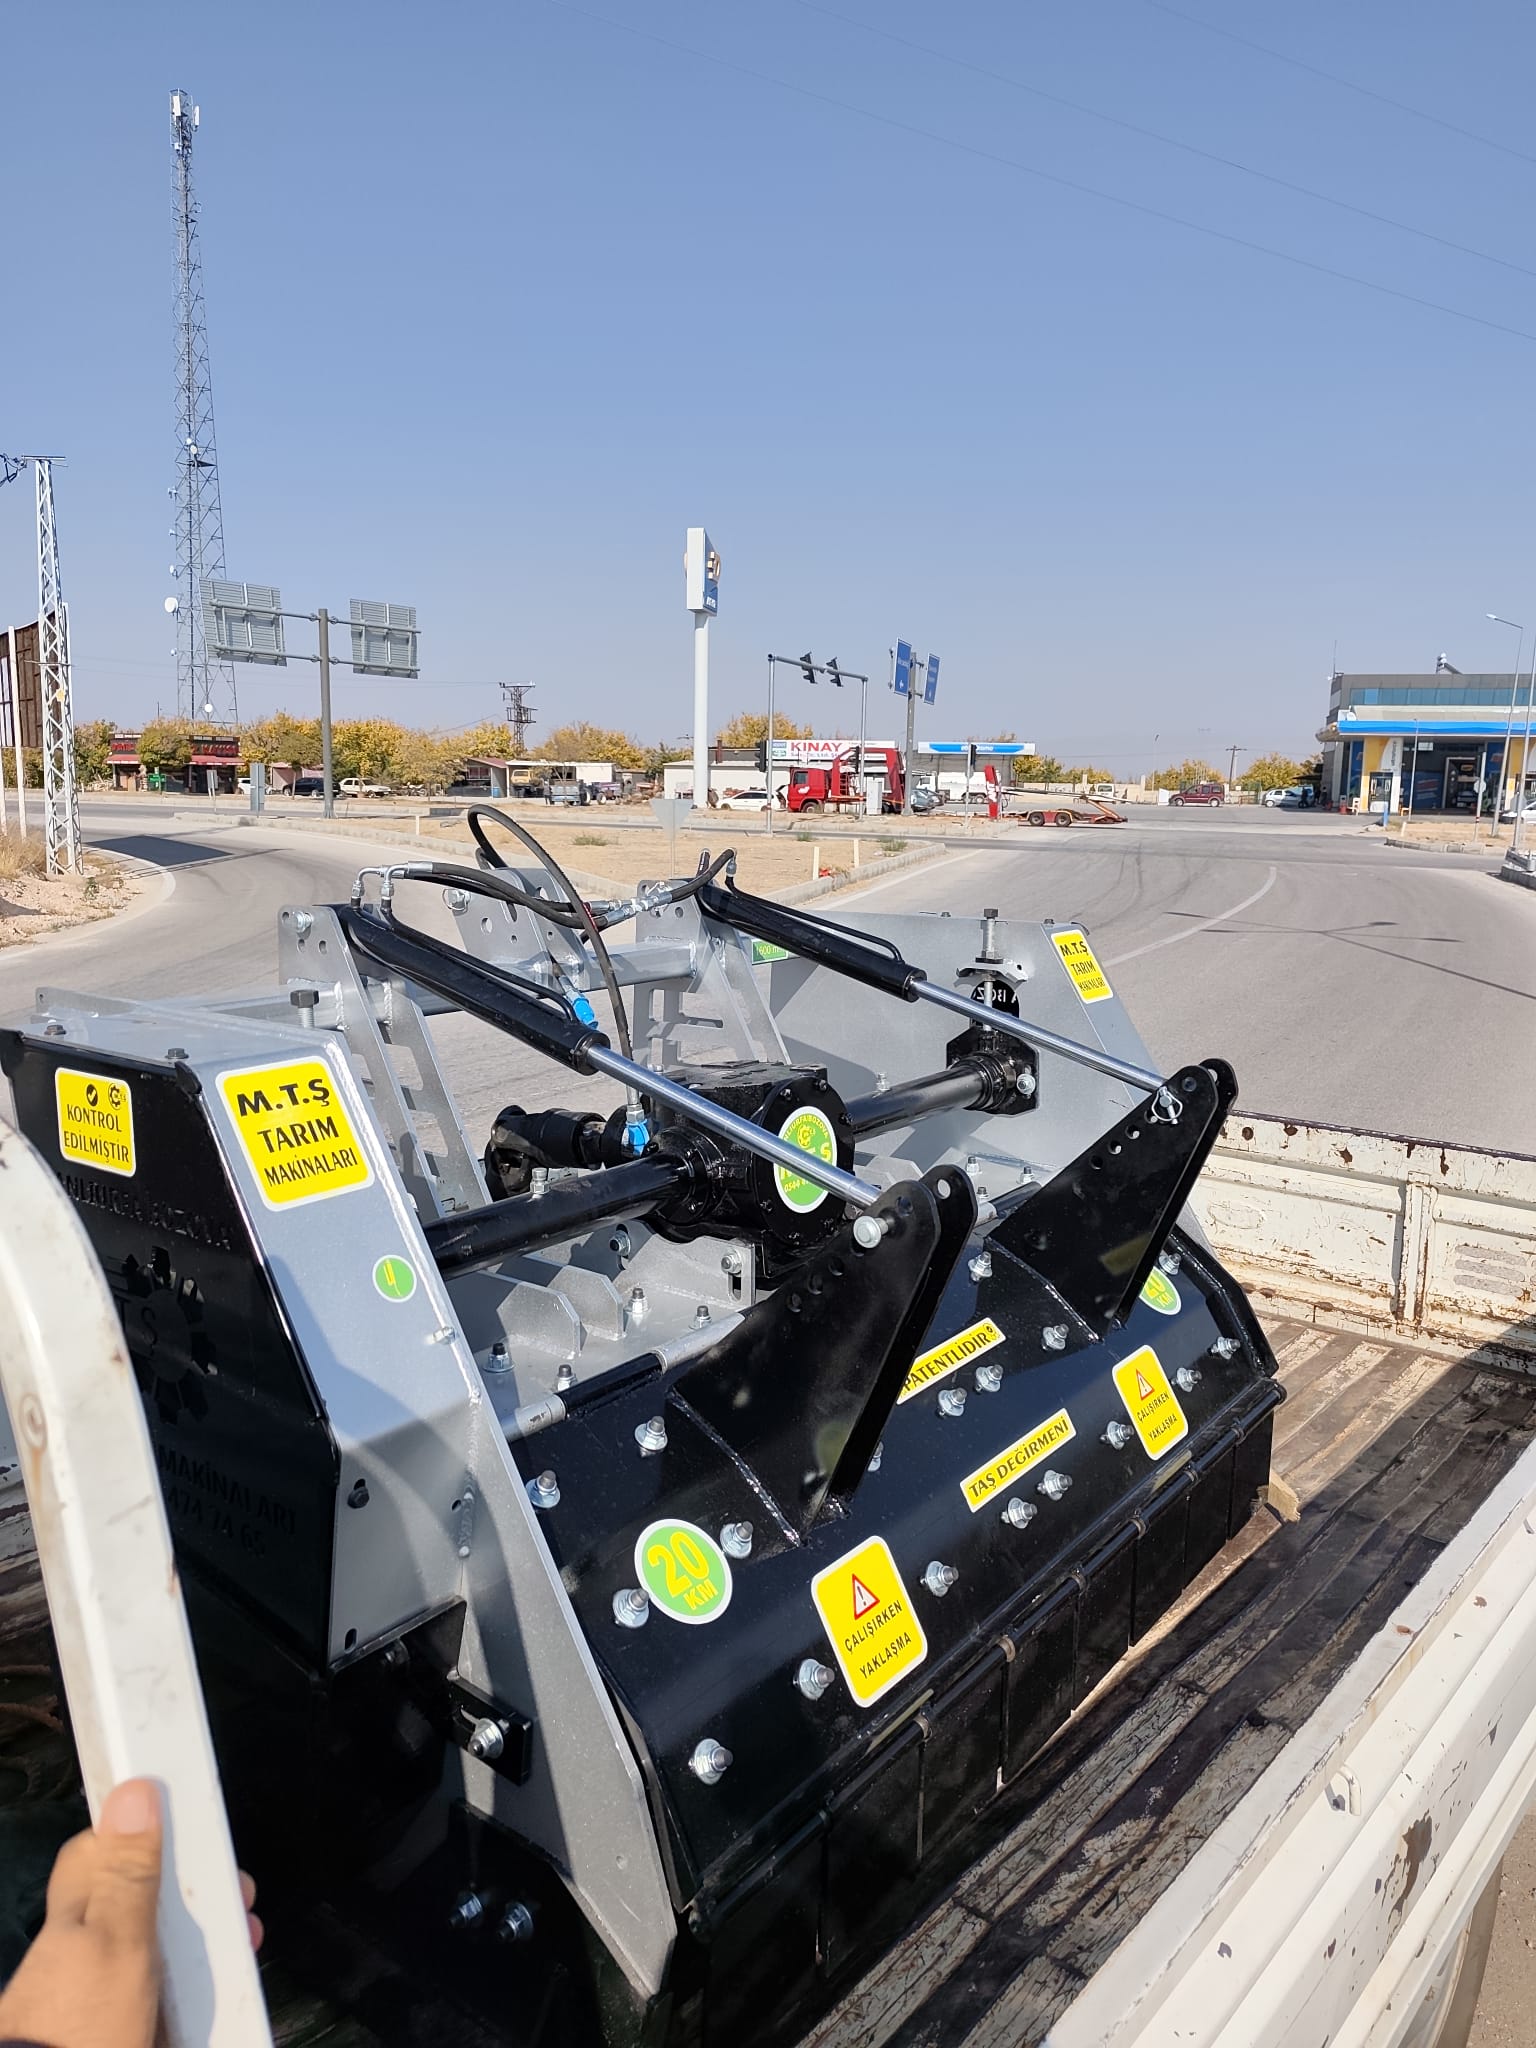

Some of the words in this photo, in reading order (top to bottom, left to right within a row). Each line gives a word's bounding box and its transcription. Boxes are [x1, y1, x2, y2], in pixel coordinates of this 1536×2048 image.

[790, 742, 843, 752] KINAY
[1070, 960, 1097, 976] TARIM
[237, 1077, 331, 1118] M.T.Ş
[66, 1103, 122, 1133] KONTROL
[257, 1115, 340, 1153] TARIM
[63, 1129, 130, 1163] EDİLMİŞTİR
[263, 1147, 359, 1187] MAKİNALARI
[902, 1331, 992, 1392] PATENTLİDİR
[1137, 1391, 1170, 1423] ÇALIŞIRKEN
[1147, 1415, 1179, 1442] YAKLAŞMA
[969, 1473, 998, 1500] TAŞ
[997, 1418, 1070, 1481] DEĞİRMENİ
[647, 1531, 710, 1599] 20
[682, 1582, 719, 1611] KM
[844, 1598, 903, 1654] ÇALIŞIRKEN
[859, 1631, 913, 1680] YAKLAŞMA
